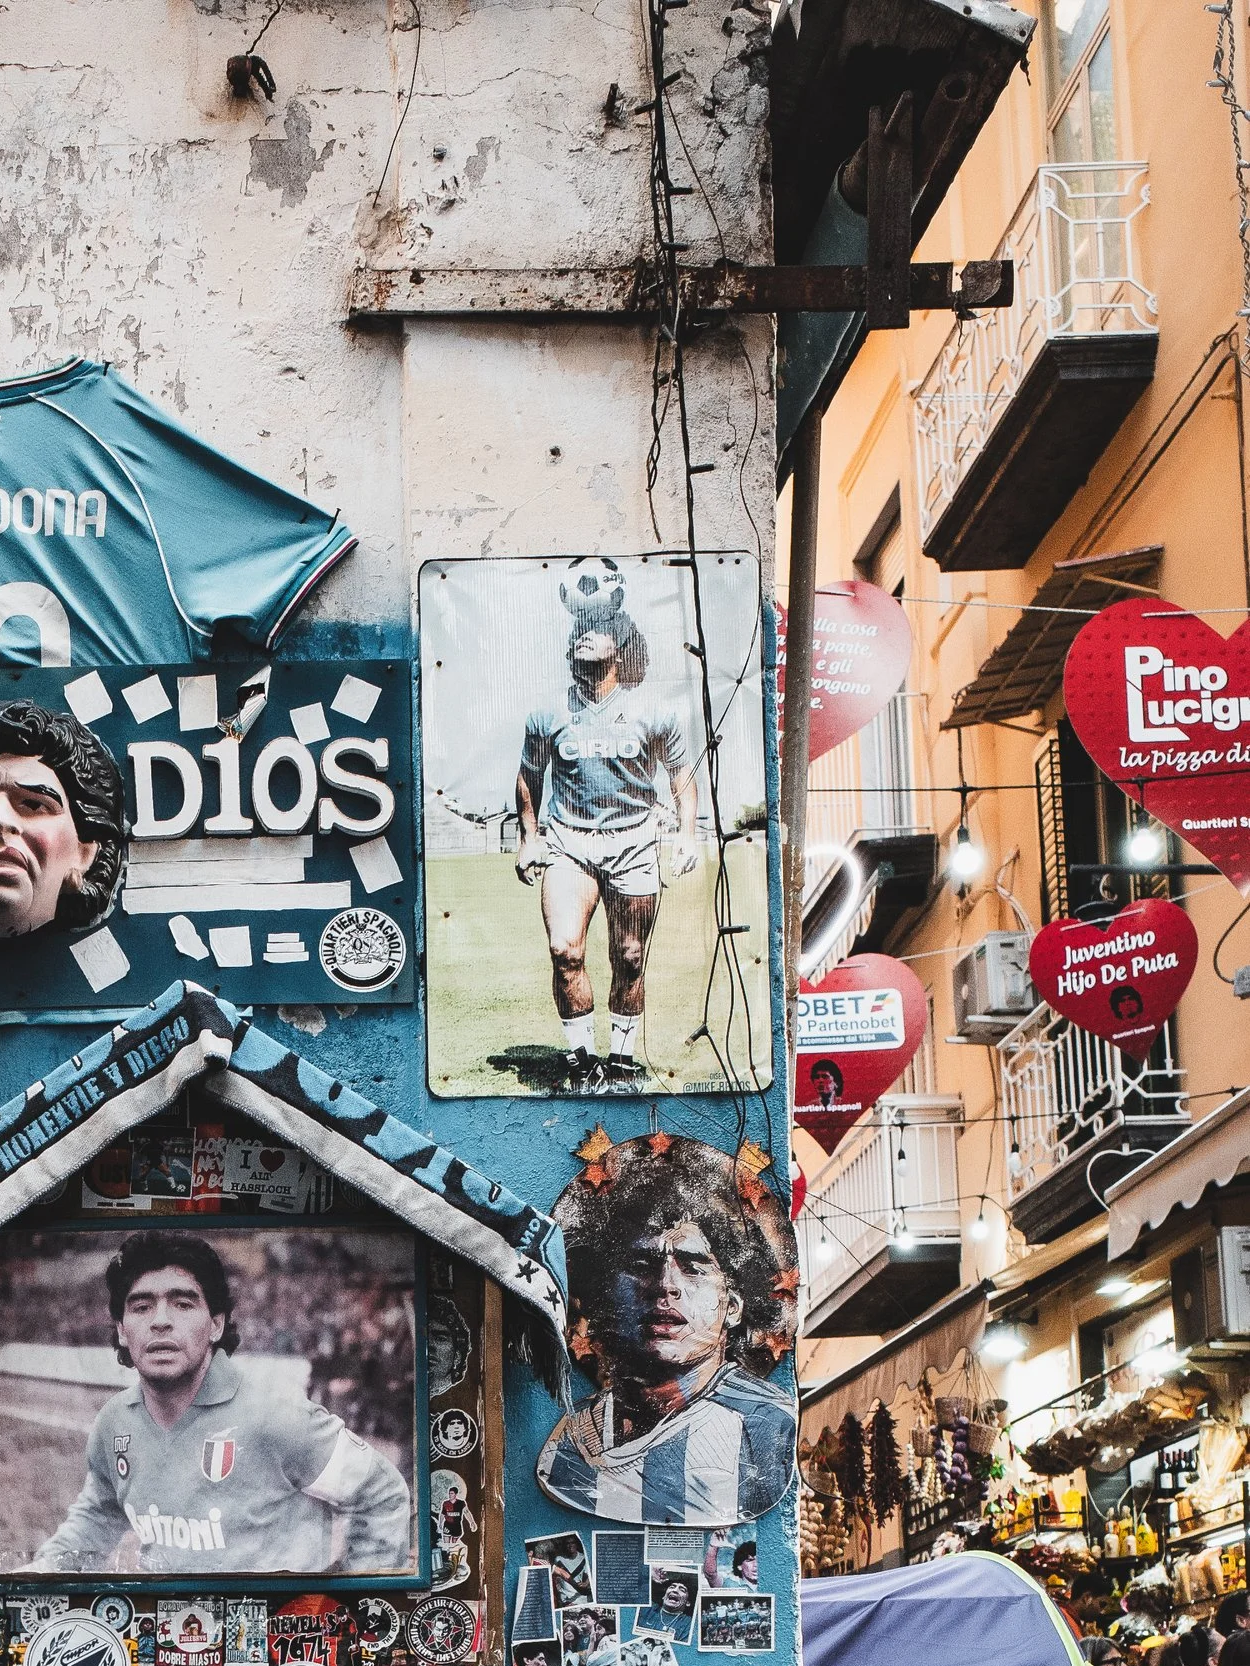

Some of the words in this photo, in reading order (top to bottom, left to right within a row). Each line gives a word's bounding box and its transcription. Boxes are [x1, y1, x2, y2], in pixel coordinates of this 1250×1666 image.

[841, 622, 879, 637] cosa
[824, 641, 874, 657] parte,
[829, 658, 852, 676] gli
[1124, 646, 1228, 692] Pino
[557, 739, 641, 762] CIRIO
[1119, 747, 1150, 768] la
[1152, 747, 1223, 773] pizza
[1182, 818, 1238, 830] Quartieri
[323, 911, 359, 965] QUARTIERI
[363, 911, 402, 964] SPAGNOLI
[1062, 930, 1156, 970] Juventino
[1057, 970, 1096, 997] Hijo
[1100, 964, 1128, 985] De
[1131, 952, 1180, 978] Puta
[807, 1015, 897, 1033] Partenobet
[230, 1183, 292, 1195] HASSLOCH
[411, 1598, 446, 1626] FERVEUR
[158, 1651, 188, 1666] DOBRE
[189, 1651, 221, 1666] MIASTO
